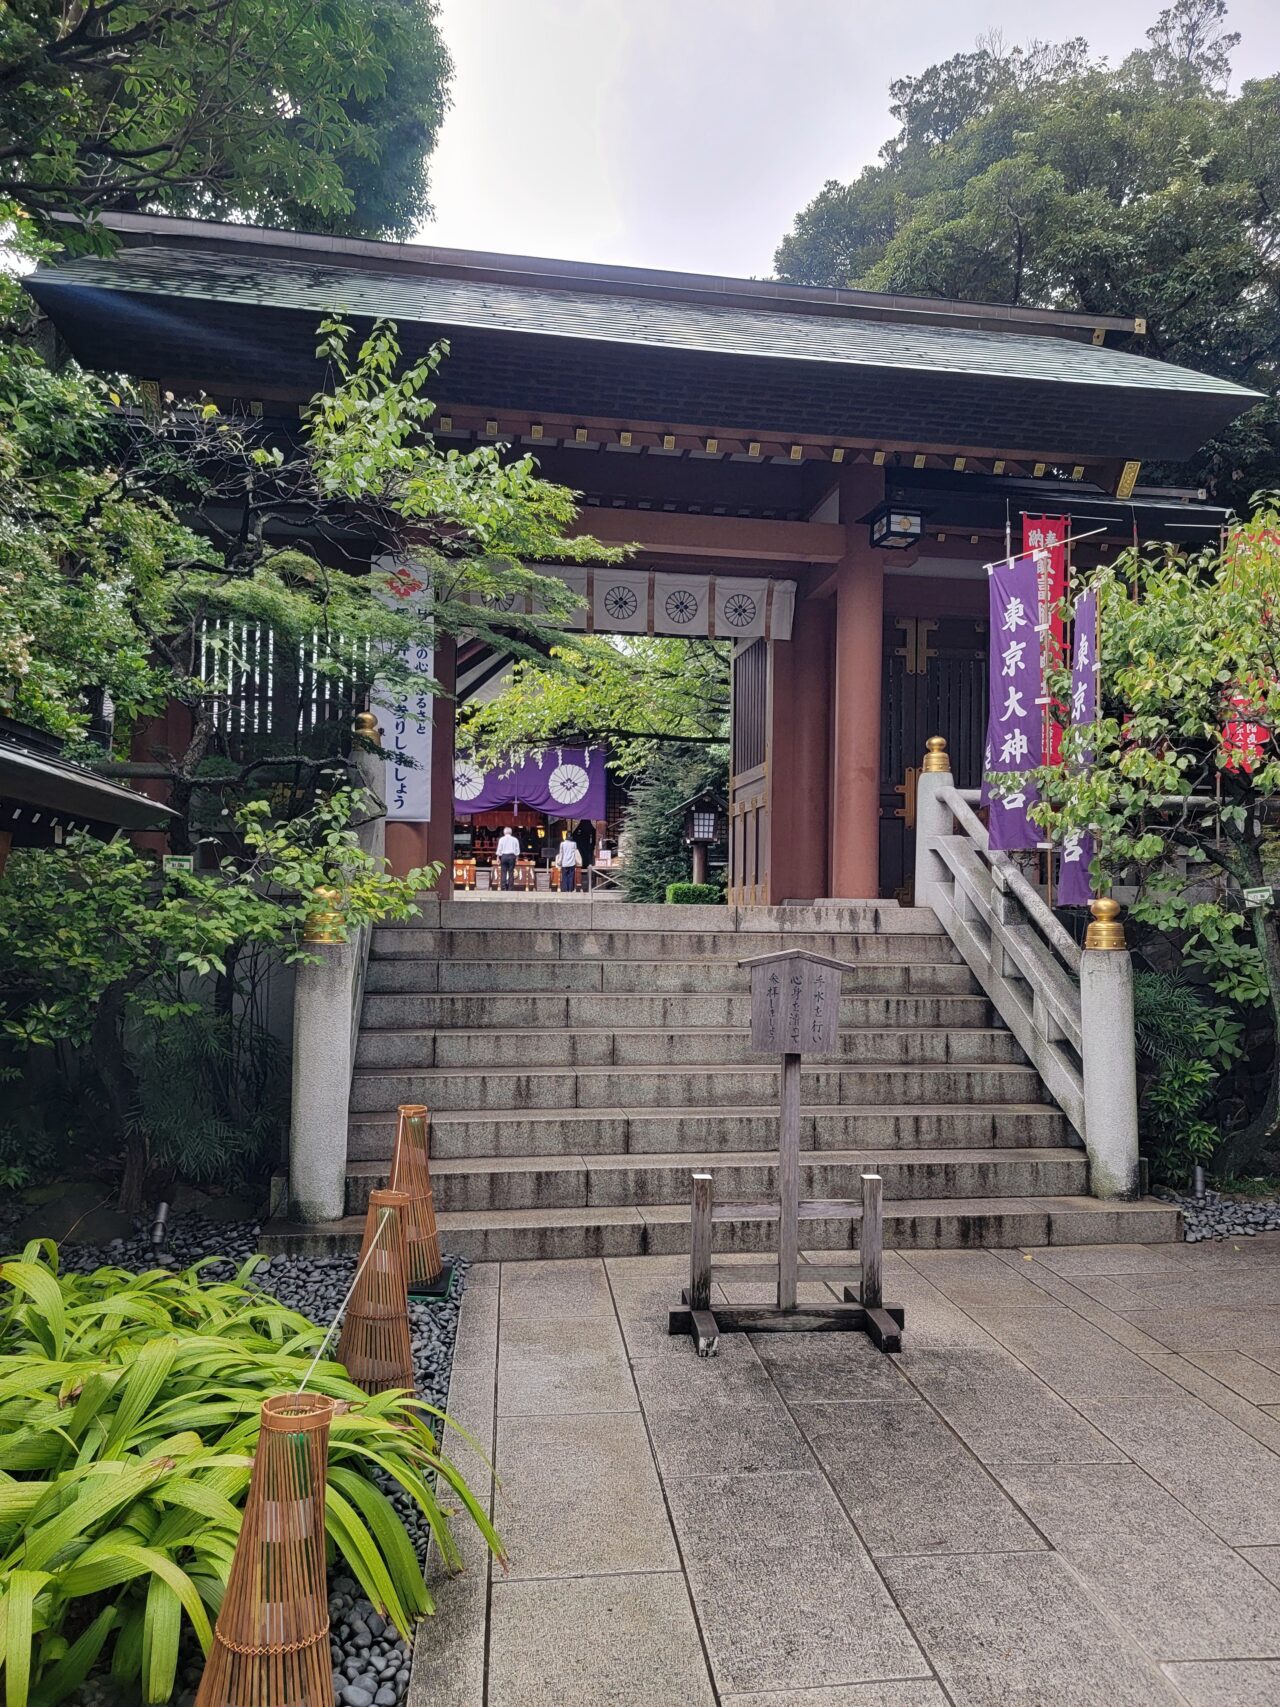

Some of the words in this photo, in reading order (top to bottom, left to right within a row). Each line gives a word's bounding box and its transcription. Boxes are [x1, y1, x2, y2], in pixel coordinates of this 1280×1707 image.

[998, 596, 1029, 810] 東京大神宮
[1063, 633, 1089, 863] 東京宮
